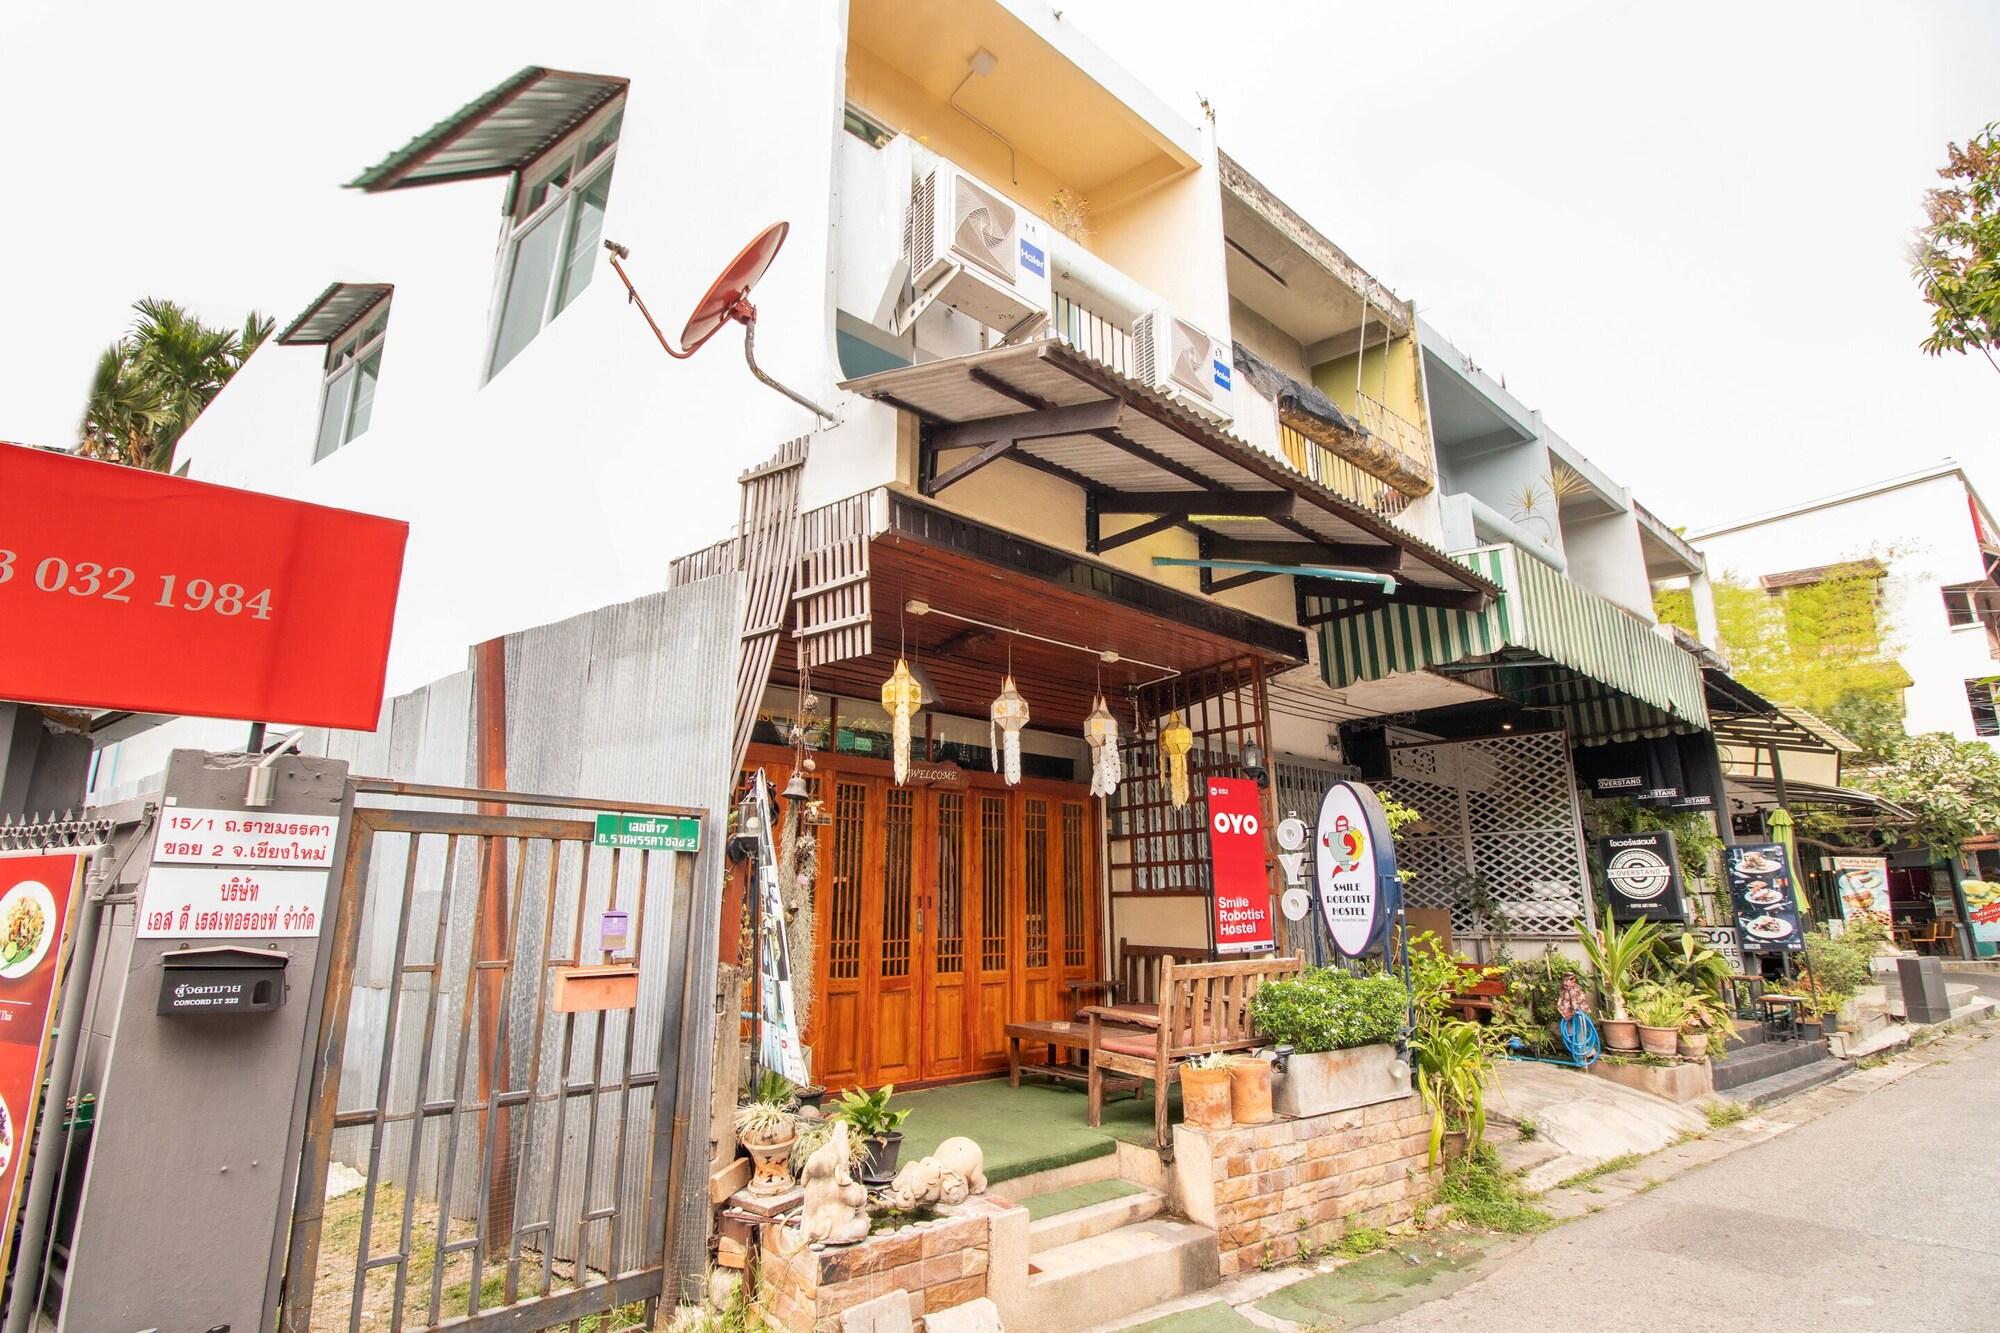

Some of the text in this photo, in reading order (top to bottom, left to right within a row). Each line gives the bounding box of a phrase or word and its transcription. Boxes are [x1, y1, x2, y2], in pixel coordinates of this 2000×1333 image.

[1020, 246, 1044, 270] Haier
[34, 556, 136, 604] 032
[153, 574, 273, 621] 1984
[909, 768, 958, 781] WELCOME
[170, 817, 215, 831] 15/1
[1214, 812, 1258, 835] OYO
[687, 838, 696, 848] 2
[211, 845, 224, 857] 2
[1616, 868, 1661, 877] OVERSTAND
[221, 877, 260, 902] บริษัท
[1333, 882, 1361, 892] SMILE
[1218, 896, 1249, 909] Smile
[1326, 894, 1371, 904] ROBOTIST
[147, 909, 174, 931] เอส
[178, 903, 192, 931] ดี
[283, 905, 315, 931] จำกัด
[1219, 908, 1265, 922] Robotist
[1332, 907, 1368, 916] HOSTEL
[1220, 921, 1257, 935] Hostel
[173, 998, 212, 1007] CONCORD
